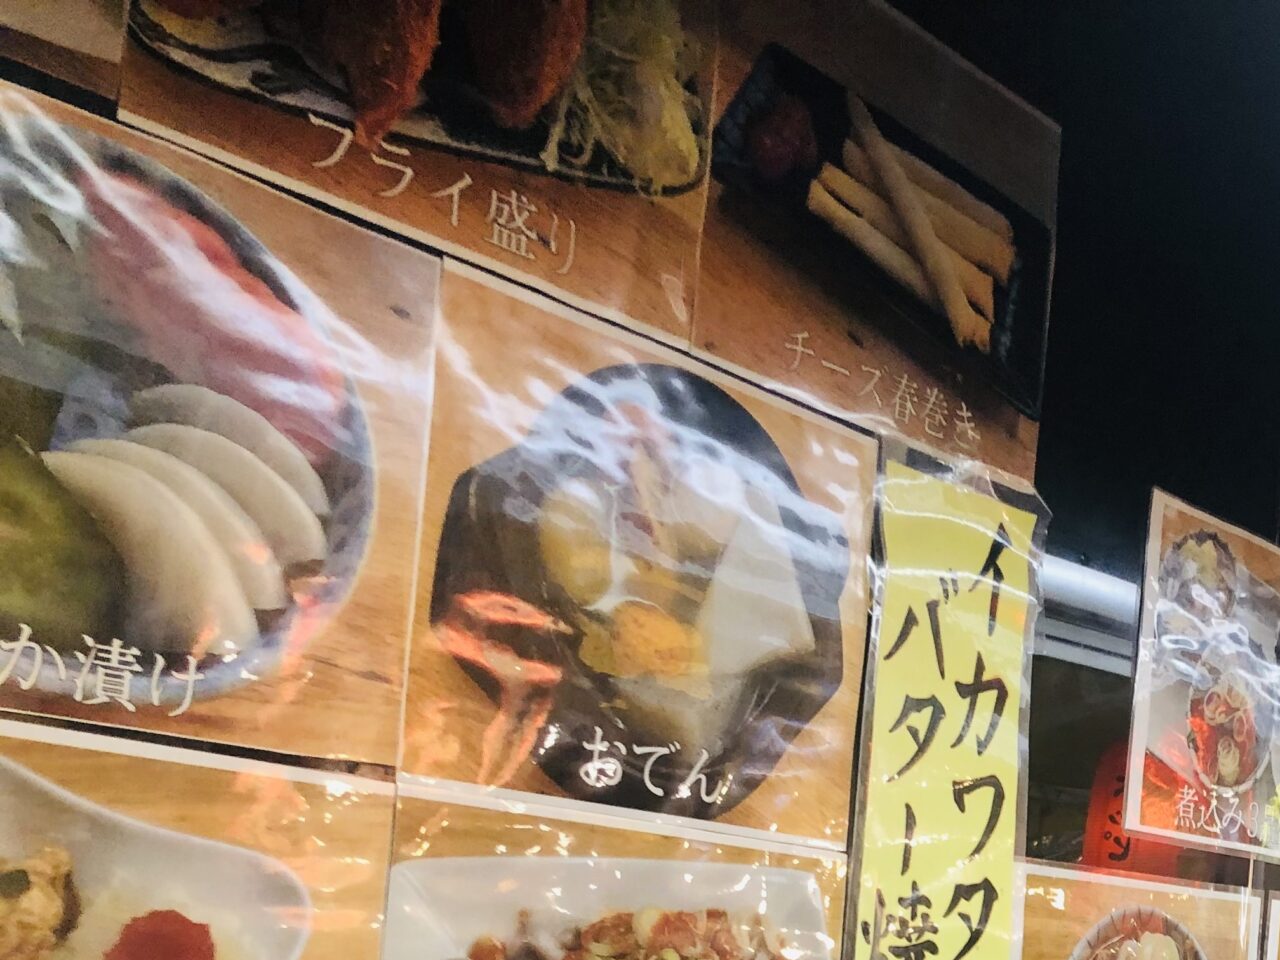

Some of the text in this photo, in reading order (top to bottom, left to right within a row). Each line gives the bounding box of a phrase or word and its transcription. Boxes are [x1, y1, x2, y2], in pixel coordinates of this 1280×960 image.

[308, 111, 576, 275] フライ盛り
[784, 331, 981, 447] チーズ春巻き
[0, 623, 205, 716] か漬け
[579, 726, 724, 804] おでん
